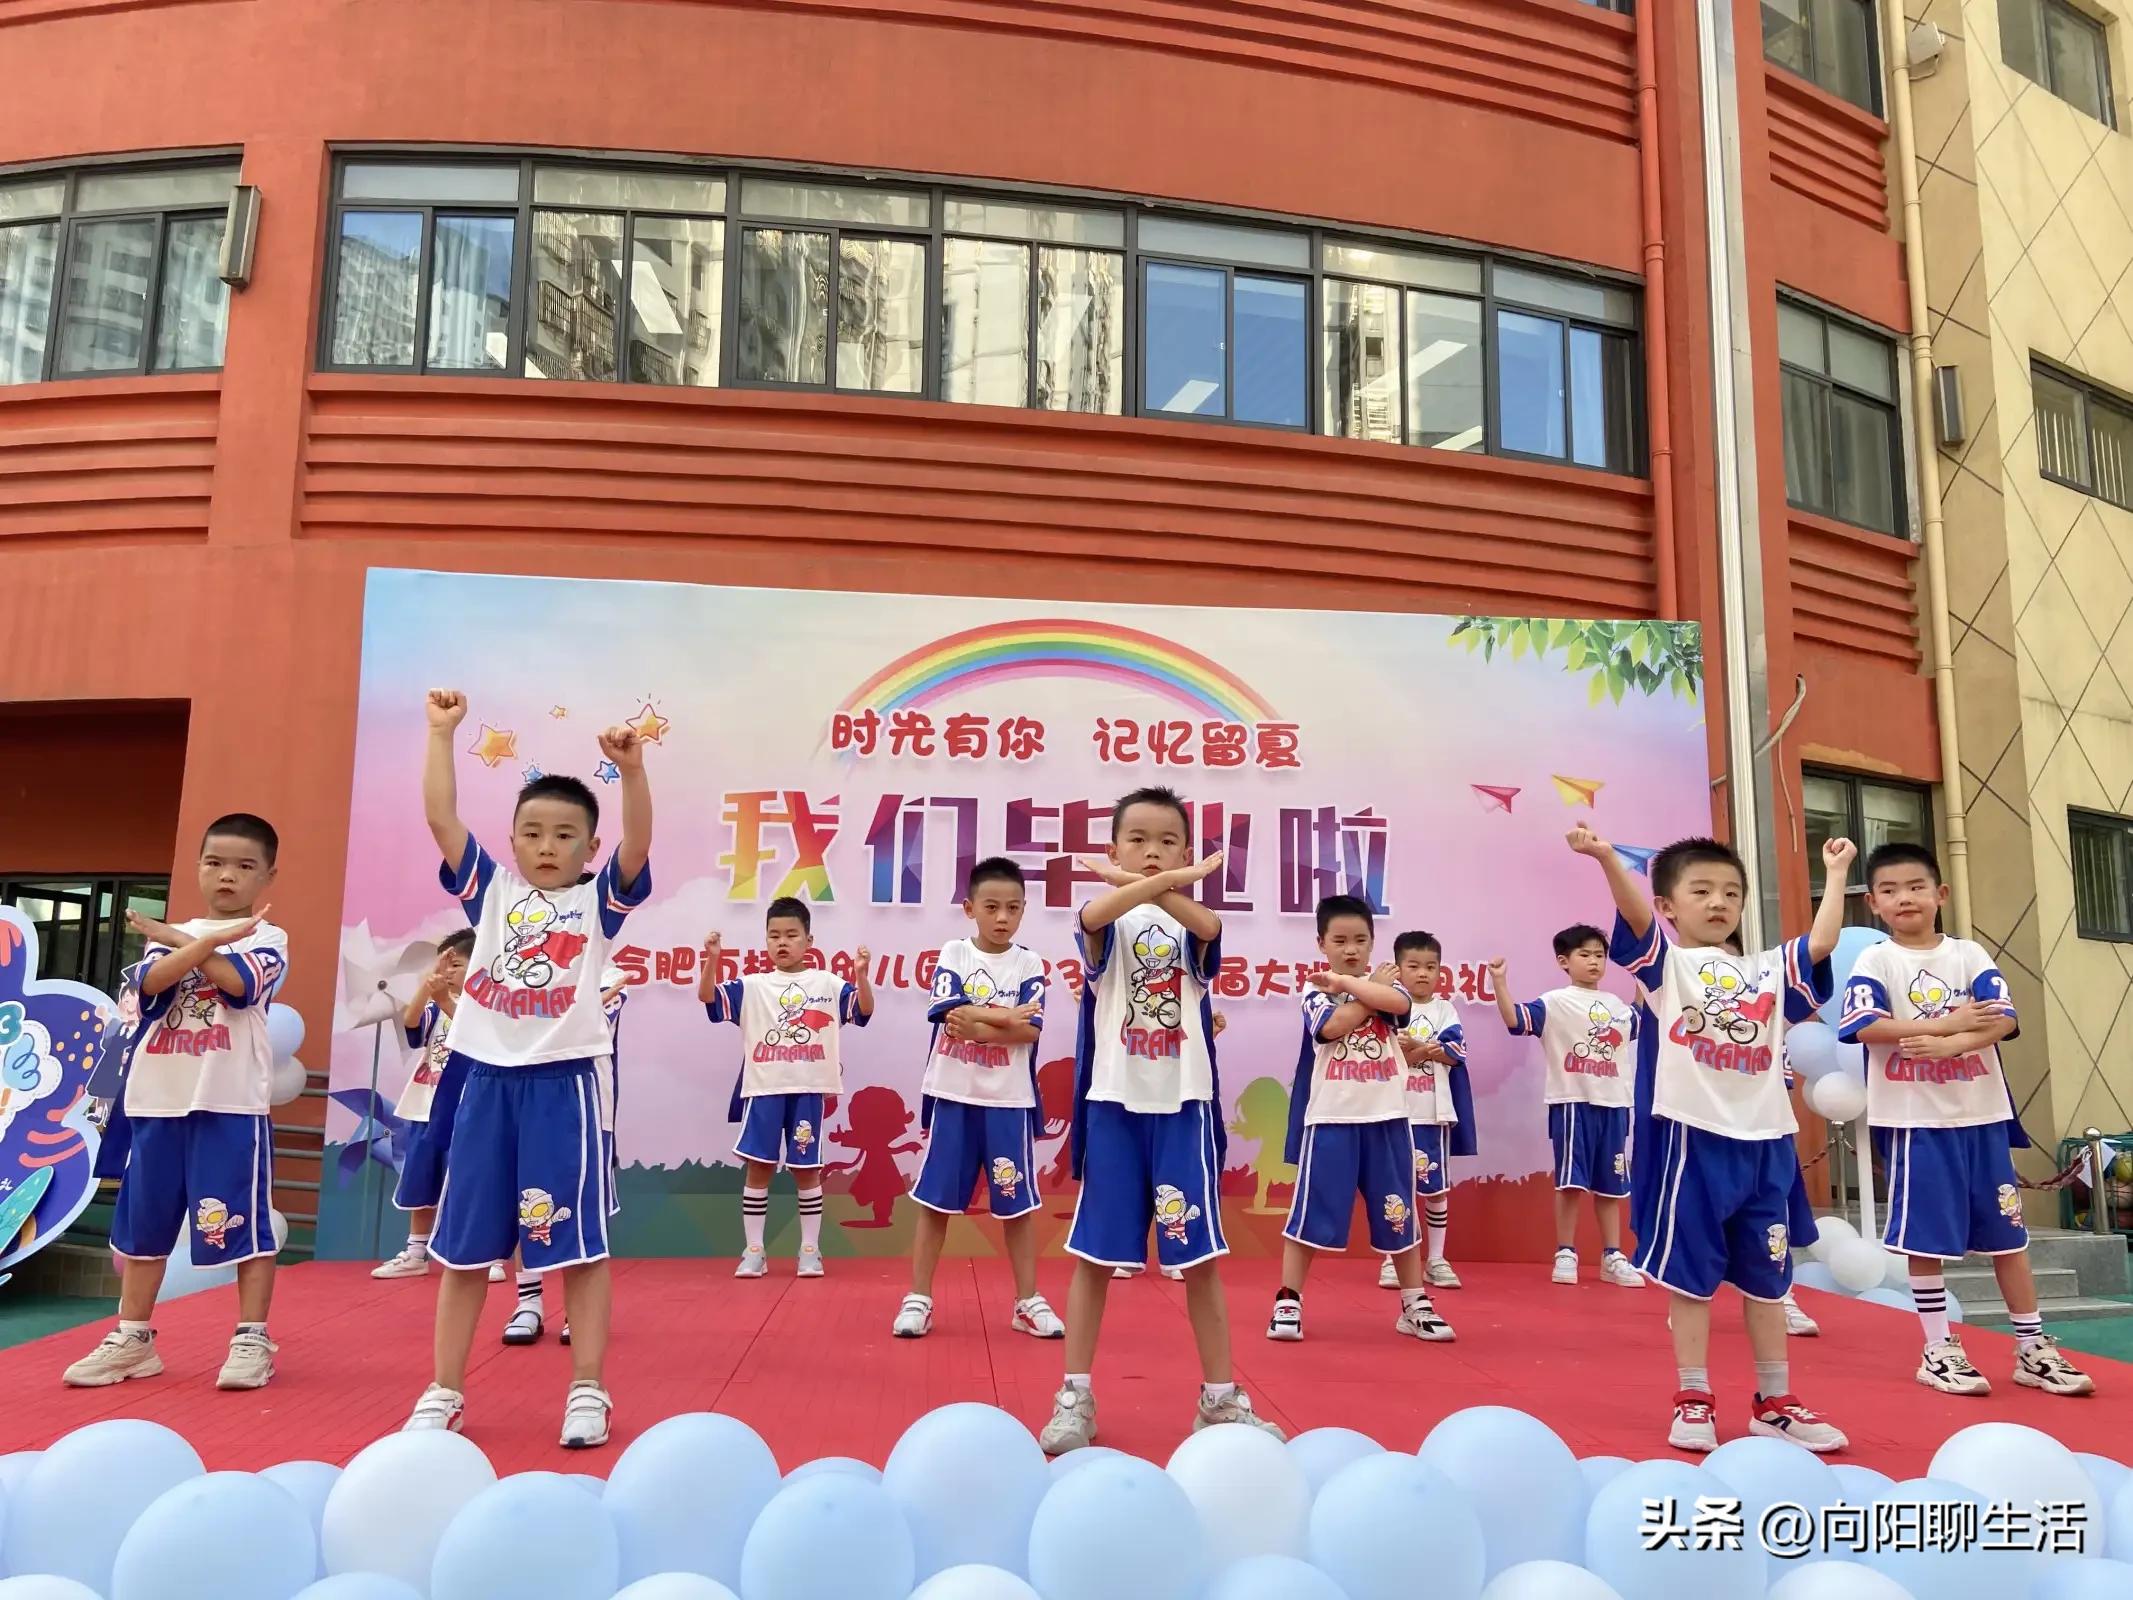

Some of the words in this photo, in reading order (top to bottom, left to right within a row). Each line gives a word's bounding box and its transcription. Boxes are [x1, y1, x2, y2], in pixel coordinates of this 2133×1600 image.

[831, 709, 1046, 761] 时光有你
[1093, 716, 1303, 769] 记忆留夏
[1843, 984, 1874, 1016] 28
